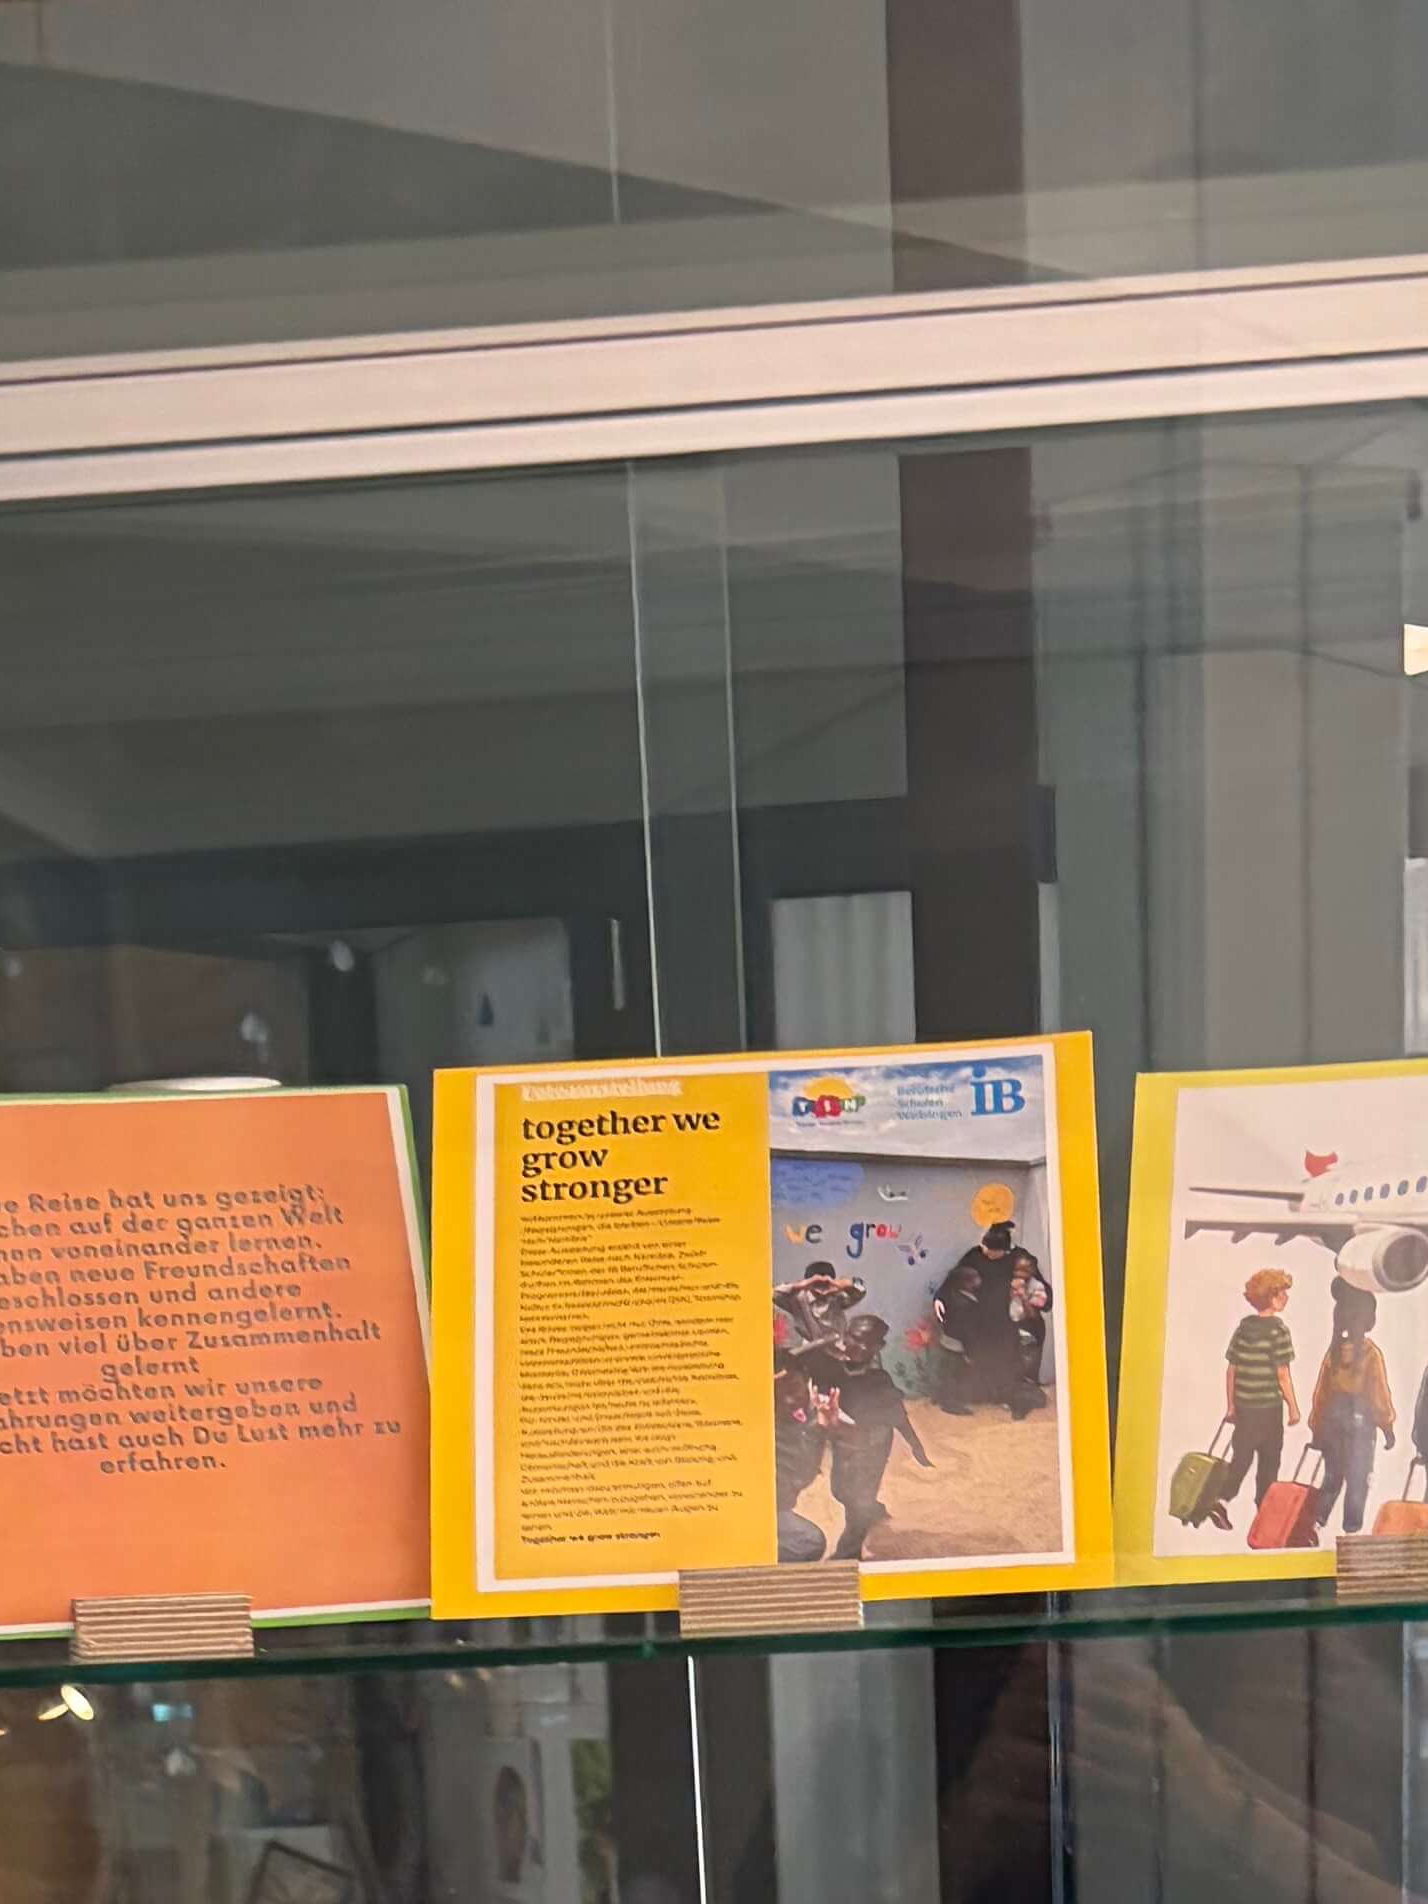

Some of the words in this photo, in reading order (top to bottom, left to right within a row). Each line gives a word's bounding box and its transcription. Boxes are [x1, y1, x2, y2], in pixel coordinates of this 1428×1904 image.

[522, 1110, 667, 1145] together
[672, 1111, 721, 1131] we
[522, 1148, 609, 1178] grow
[521, 1176, 669, 1205] stronger
